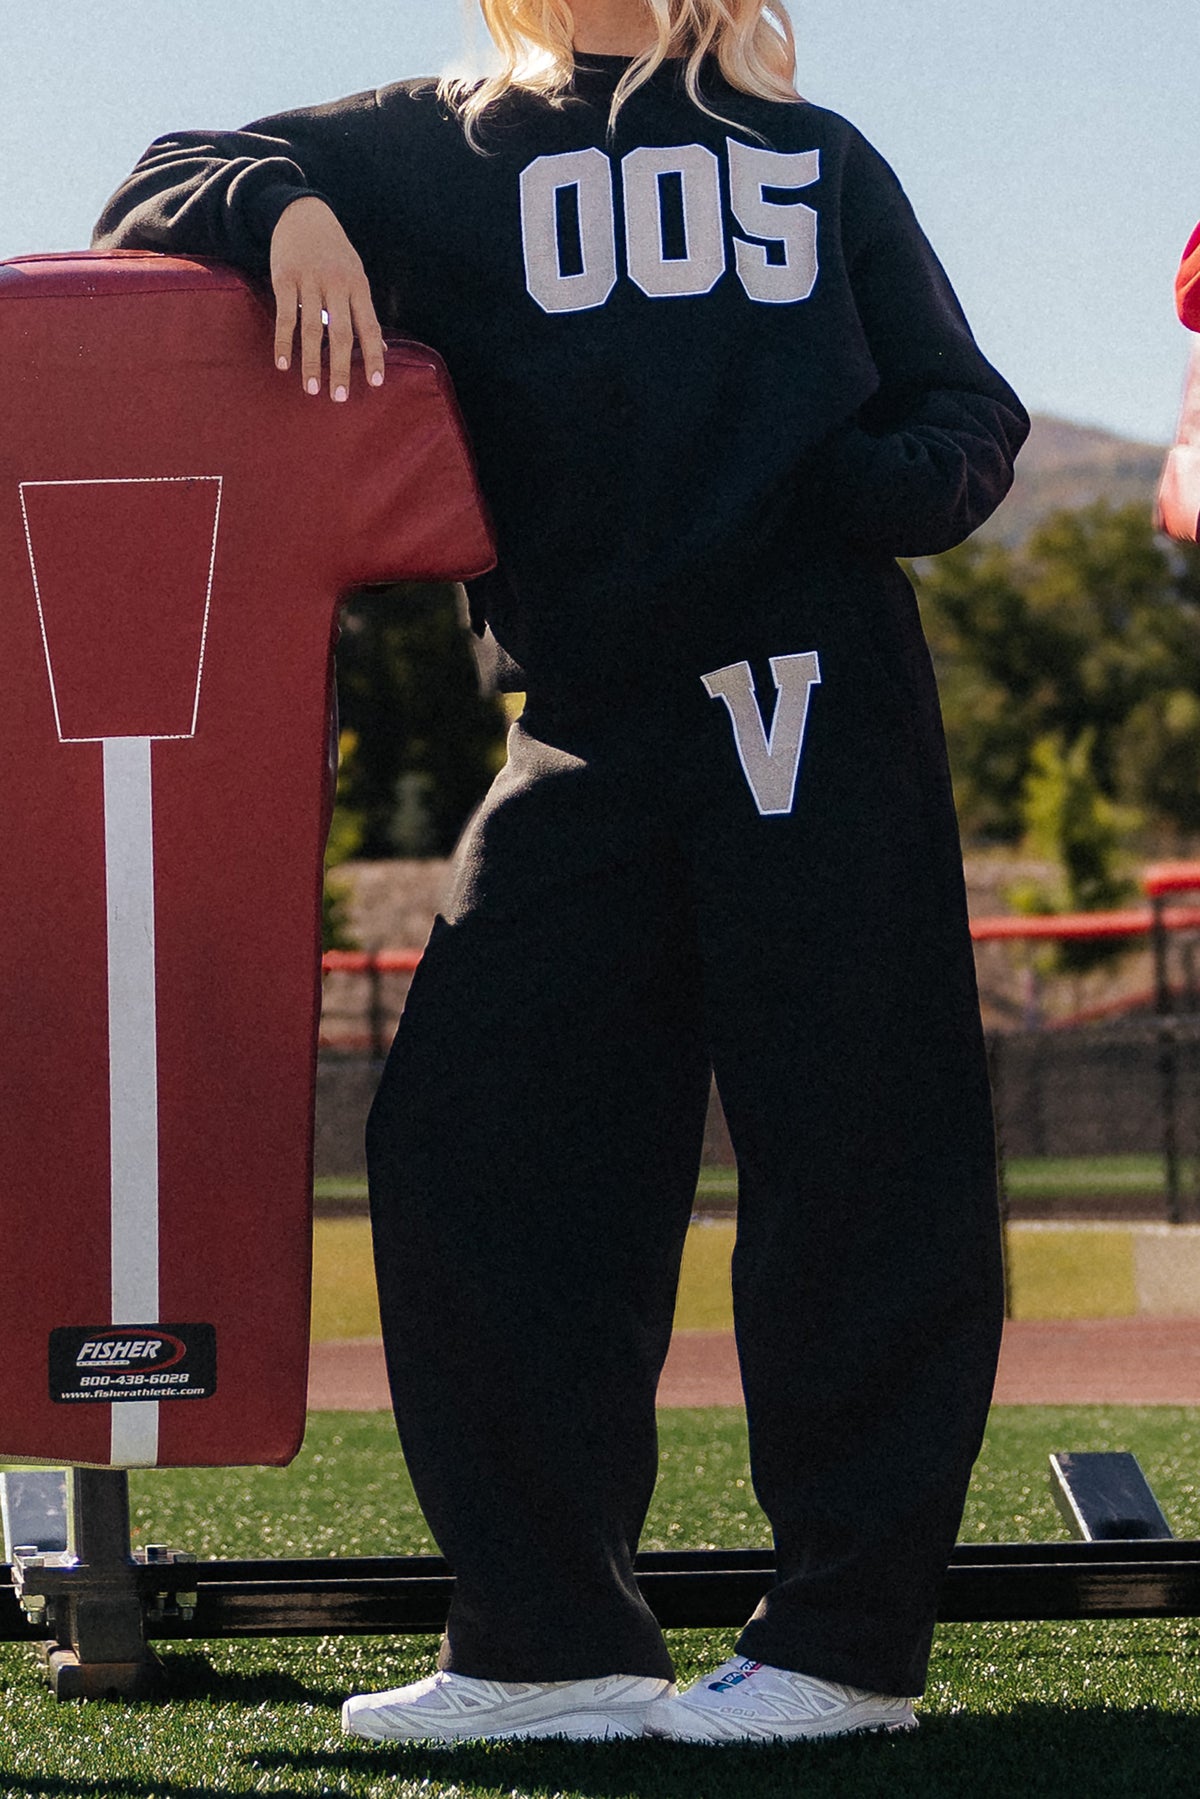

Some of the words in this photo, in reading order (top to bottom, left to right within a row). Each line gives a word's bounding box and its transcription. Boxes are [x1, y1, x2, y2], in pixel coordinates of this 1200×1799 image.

[519, 136, 820, 313] 005
[700, 651, 821, 815] V
[77, 1340, 162, 1360] FISHER
[80, 1373, 190, 1387] 800-438-6028
[61, 1387, 205, 1399] www.fisherathletic.com
